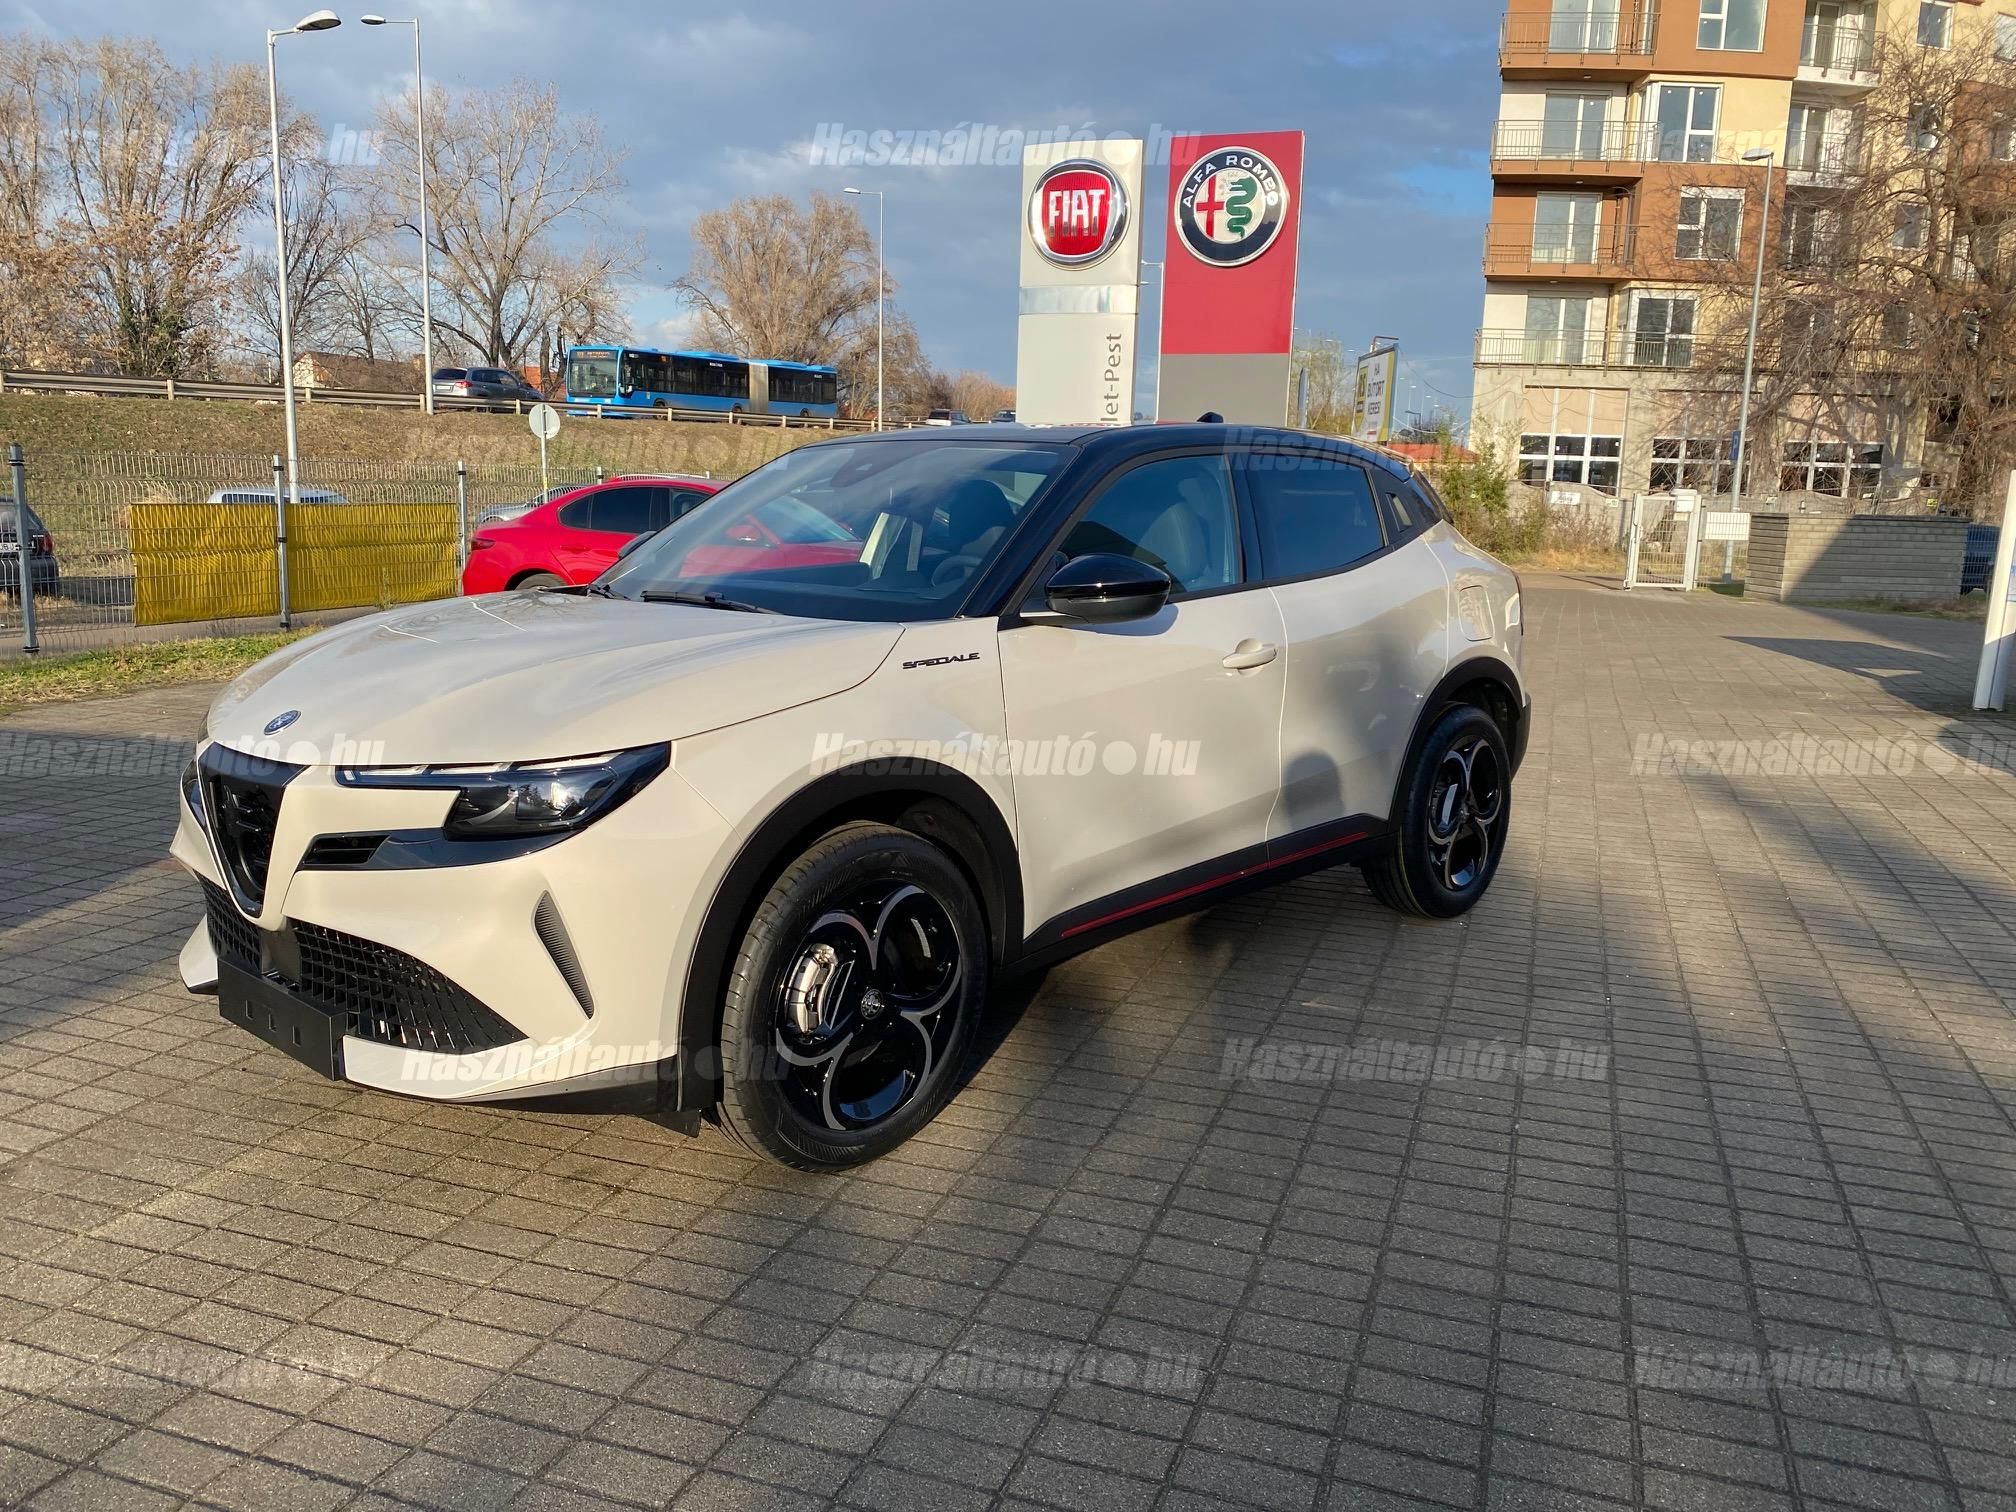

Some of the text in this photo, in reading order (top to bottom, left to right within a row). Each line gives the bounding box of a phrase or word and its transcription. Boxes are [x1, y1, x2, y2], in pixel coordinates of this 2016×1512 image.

[1182, 154, 1279, 208] ALFA ROMEO
[1049, 189, 1105, 237] FIAT
